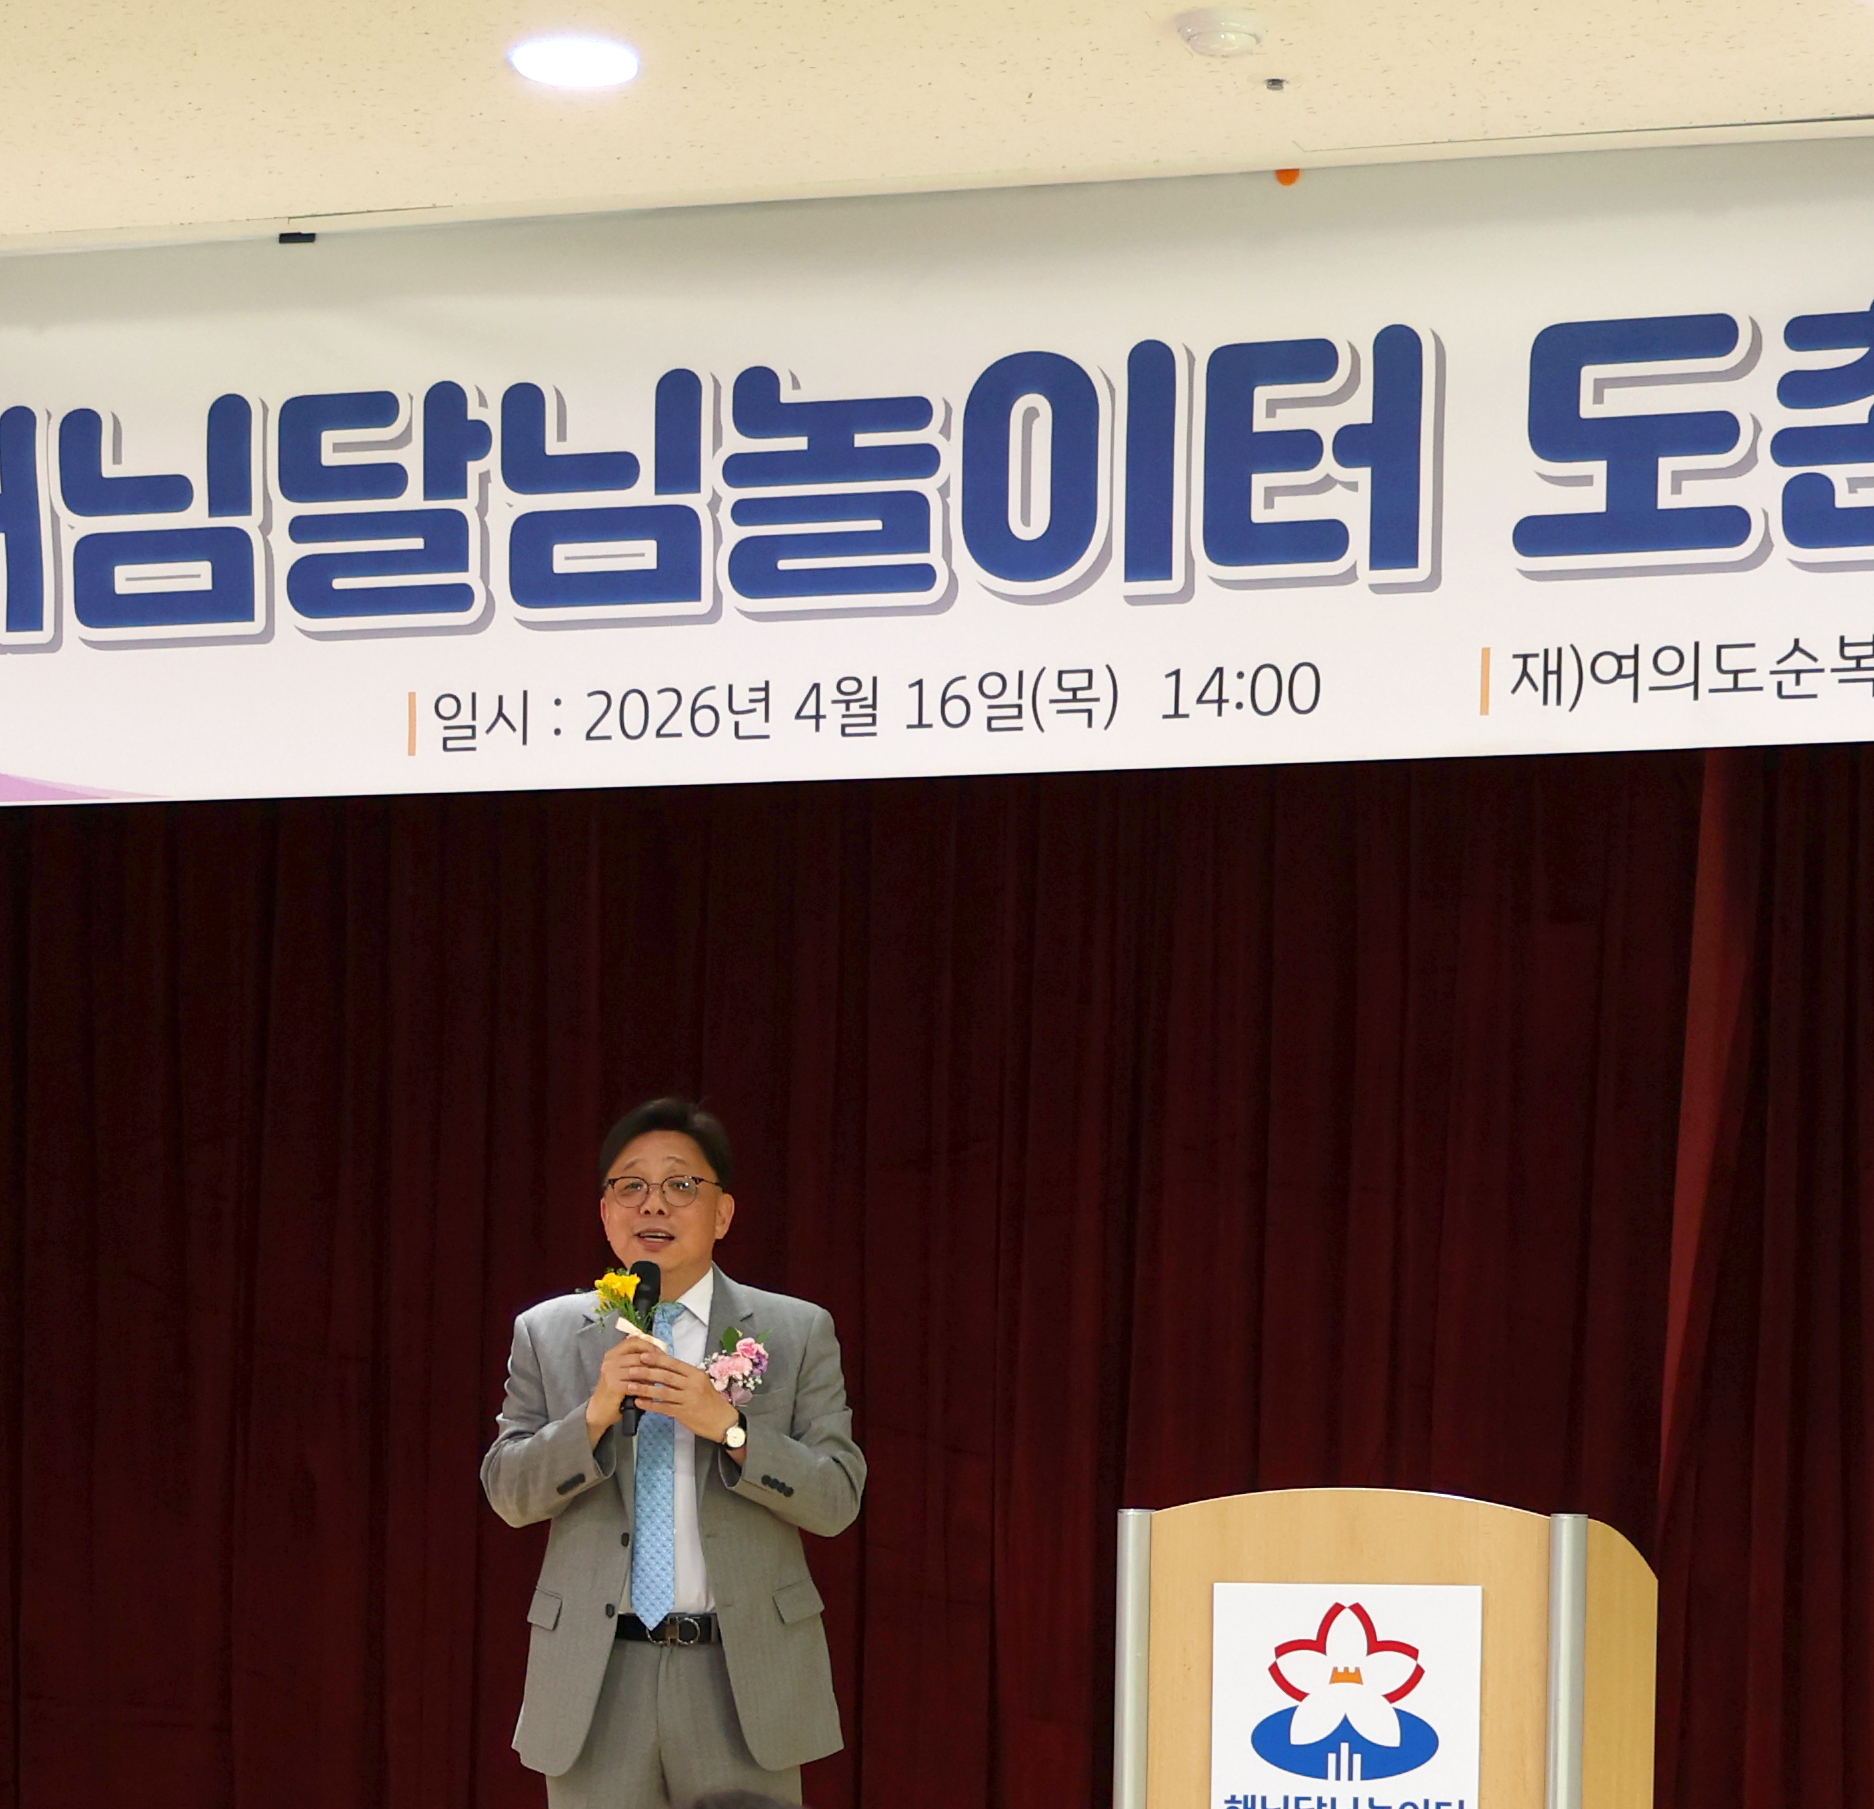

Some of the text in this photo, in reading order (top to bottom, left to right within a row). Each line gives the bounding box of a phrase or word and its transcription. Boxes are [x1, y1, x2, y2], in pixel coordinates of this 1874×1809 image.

[433, 688, 528, 752] 일시
[584, 680, 771, 741] 2026년
[793, 675, 879, 738] 4월
[905, 664, 1119, 734] 16일(목)
[1161, 661, 1322, 720] 14:00
